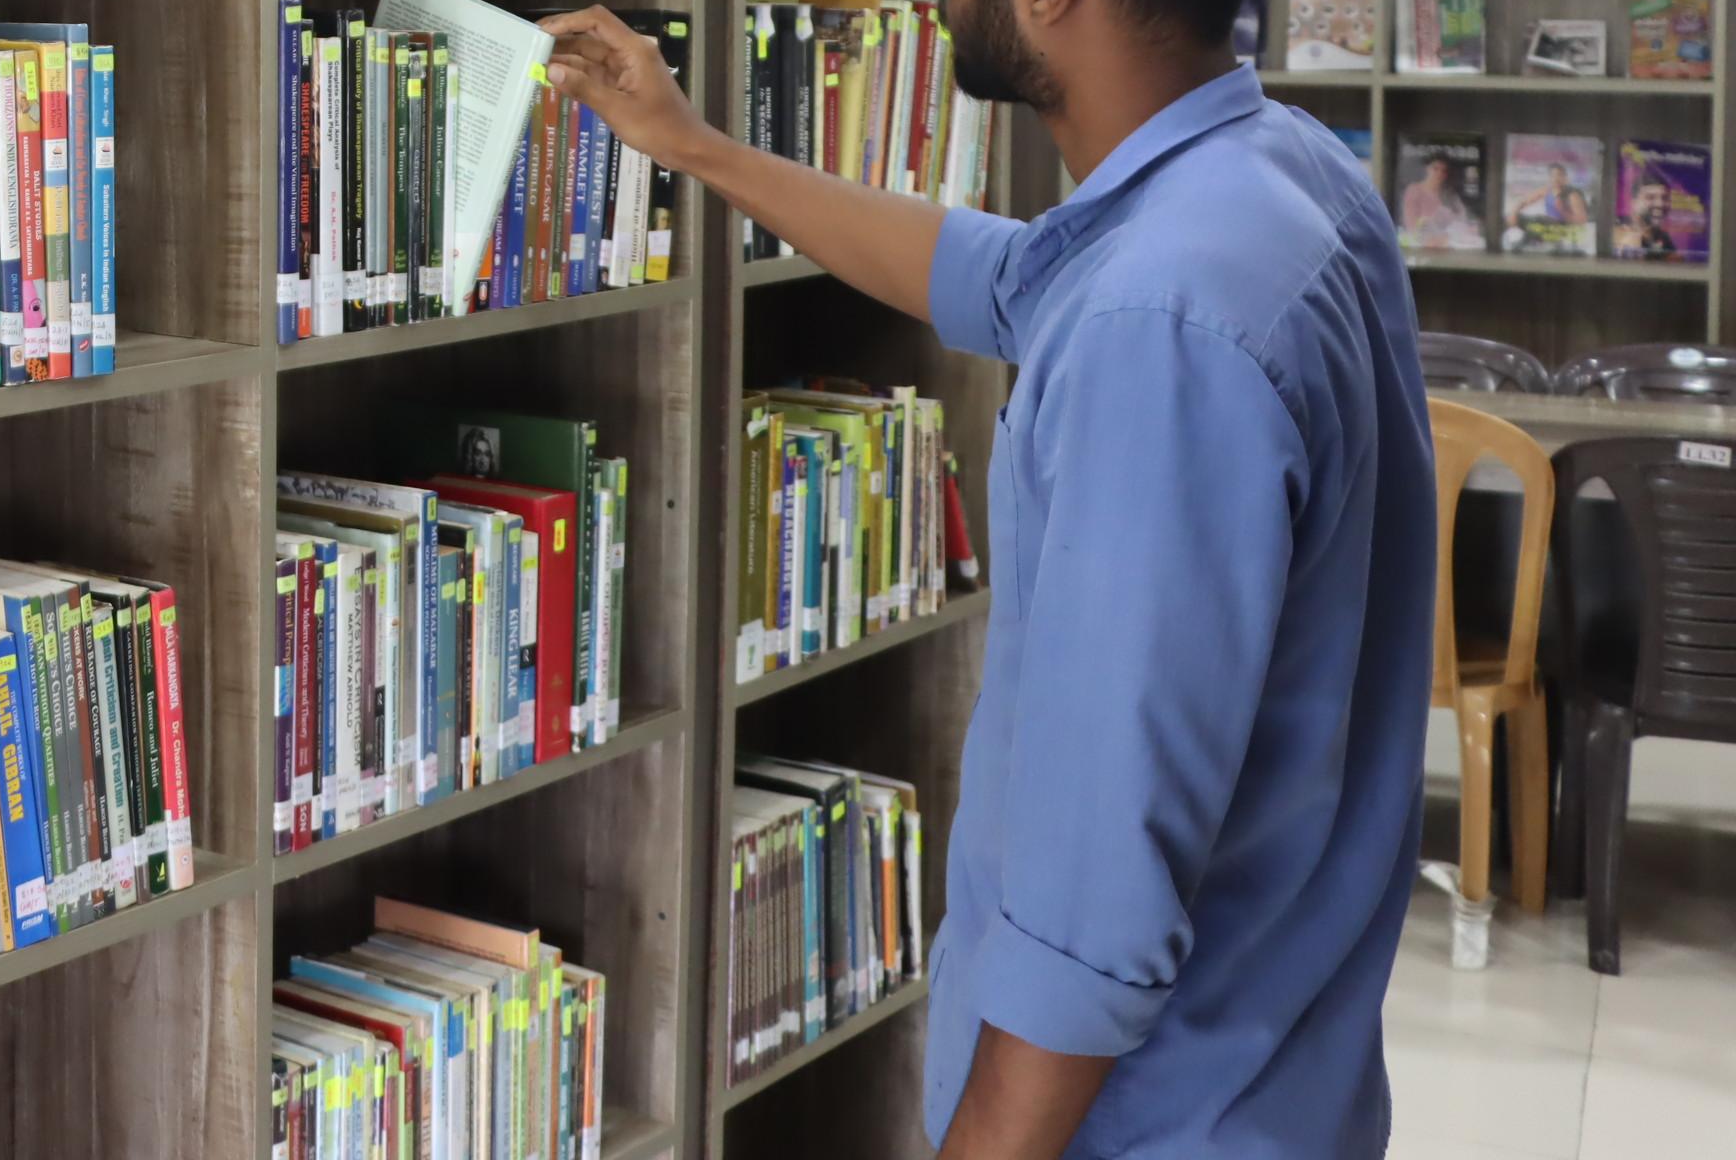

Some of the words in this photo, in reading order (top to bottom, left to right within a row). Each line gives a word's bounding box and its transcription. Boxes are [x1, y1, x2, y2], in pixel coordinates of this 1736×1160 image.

[301, 82, 310, 155] SHAKESPEARE
[529, 144, 540, 206] OTHELLO
[564, 148, 577, 213] MACBETH
[576, 131, 590, 204] HAMLET
[590, 141, 606, 224] TEMPEST
[301, 174, 310, 223] FREEDOM
[508, 608, 518, 650] KING
[347, 676, 355, 728] ARNOLD
[507, 655, 519, 698] LEAR
[146, 691, 156, 729] Romeo
[148, 733, 157, 753] and
[2, 745, 24, 822] GIBRAN
[149, 756, 160, 787] Juliet
